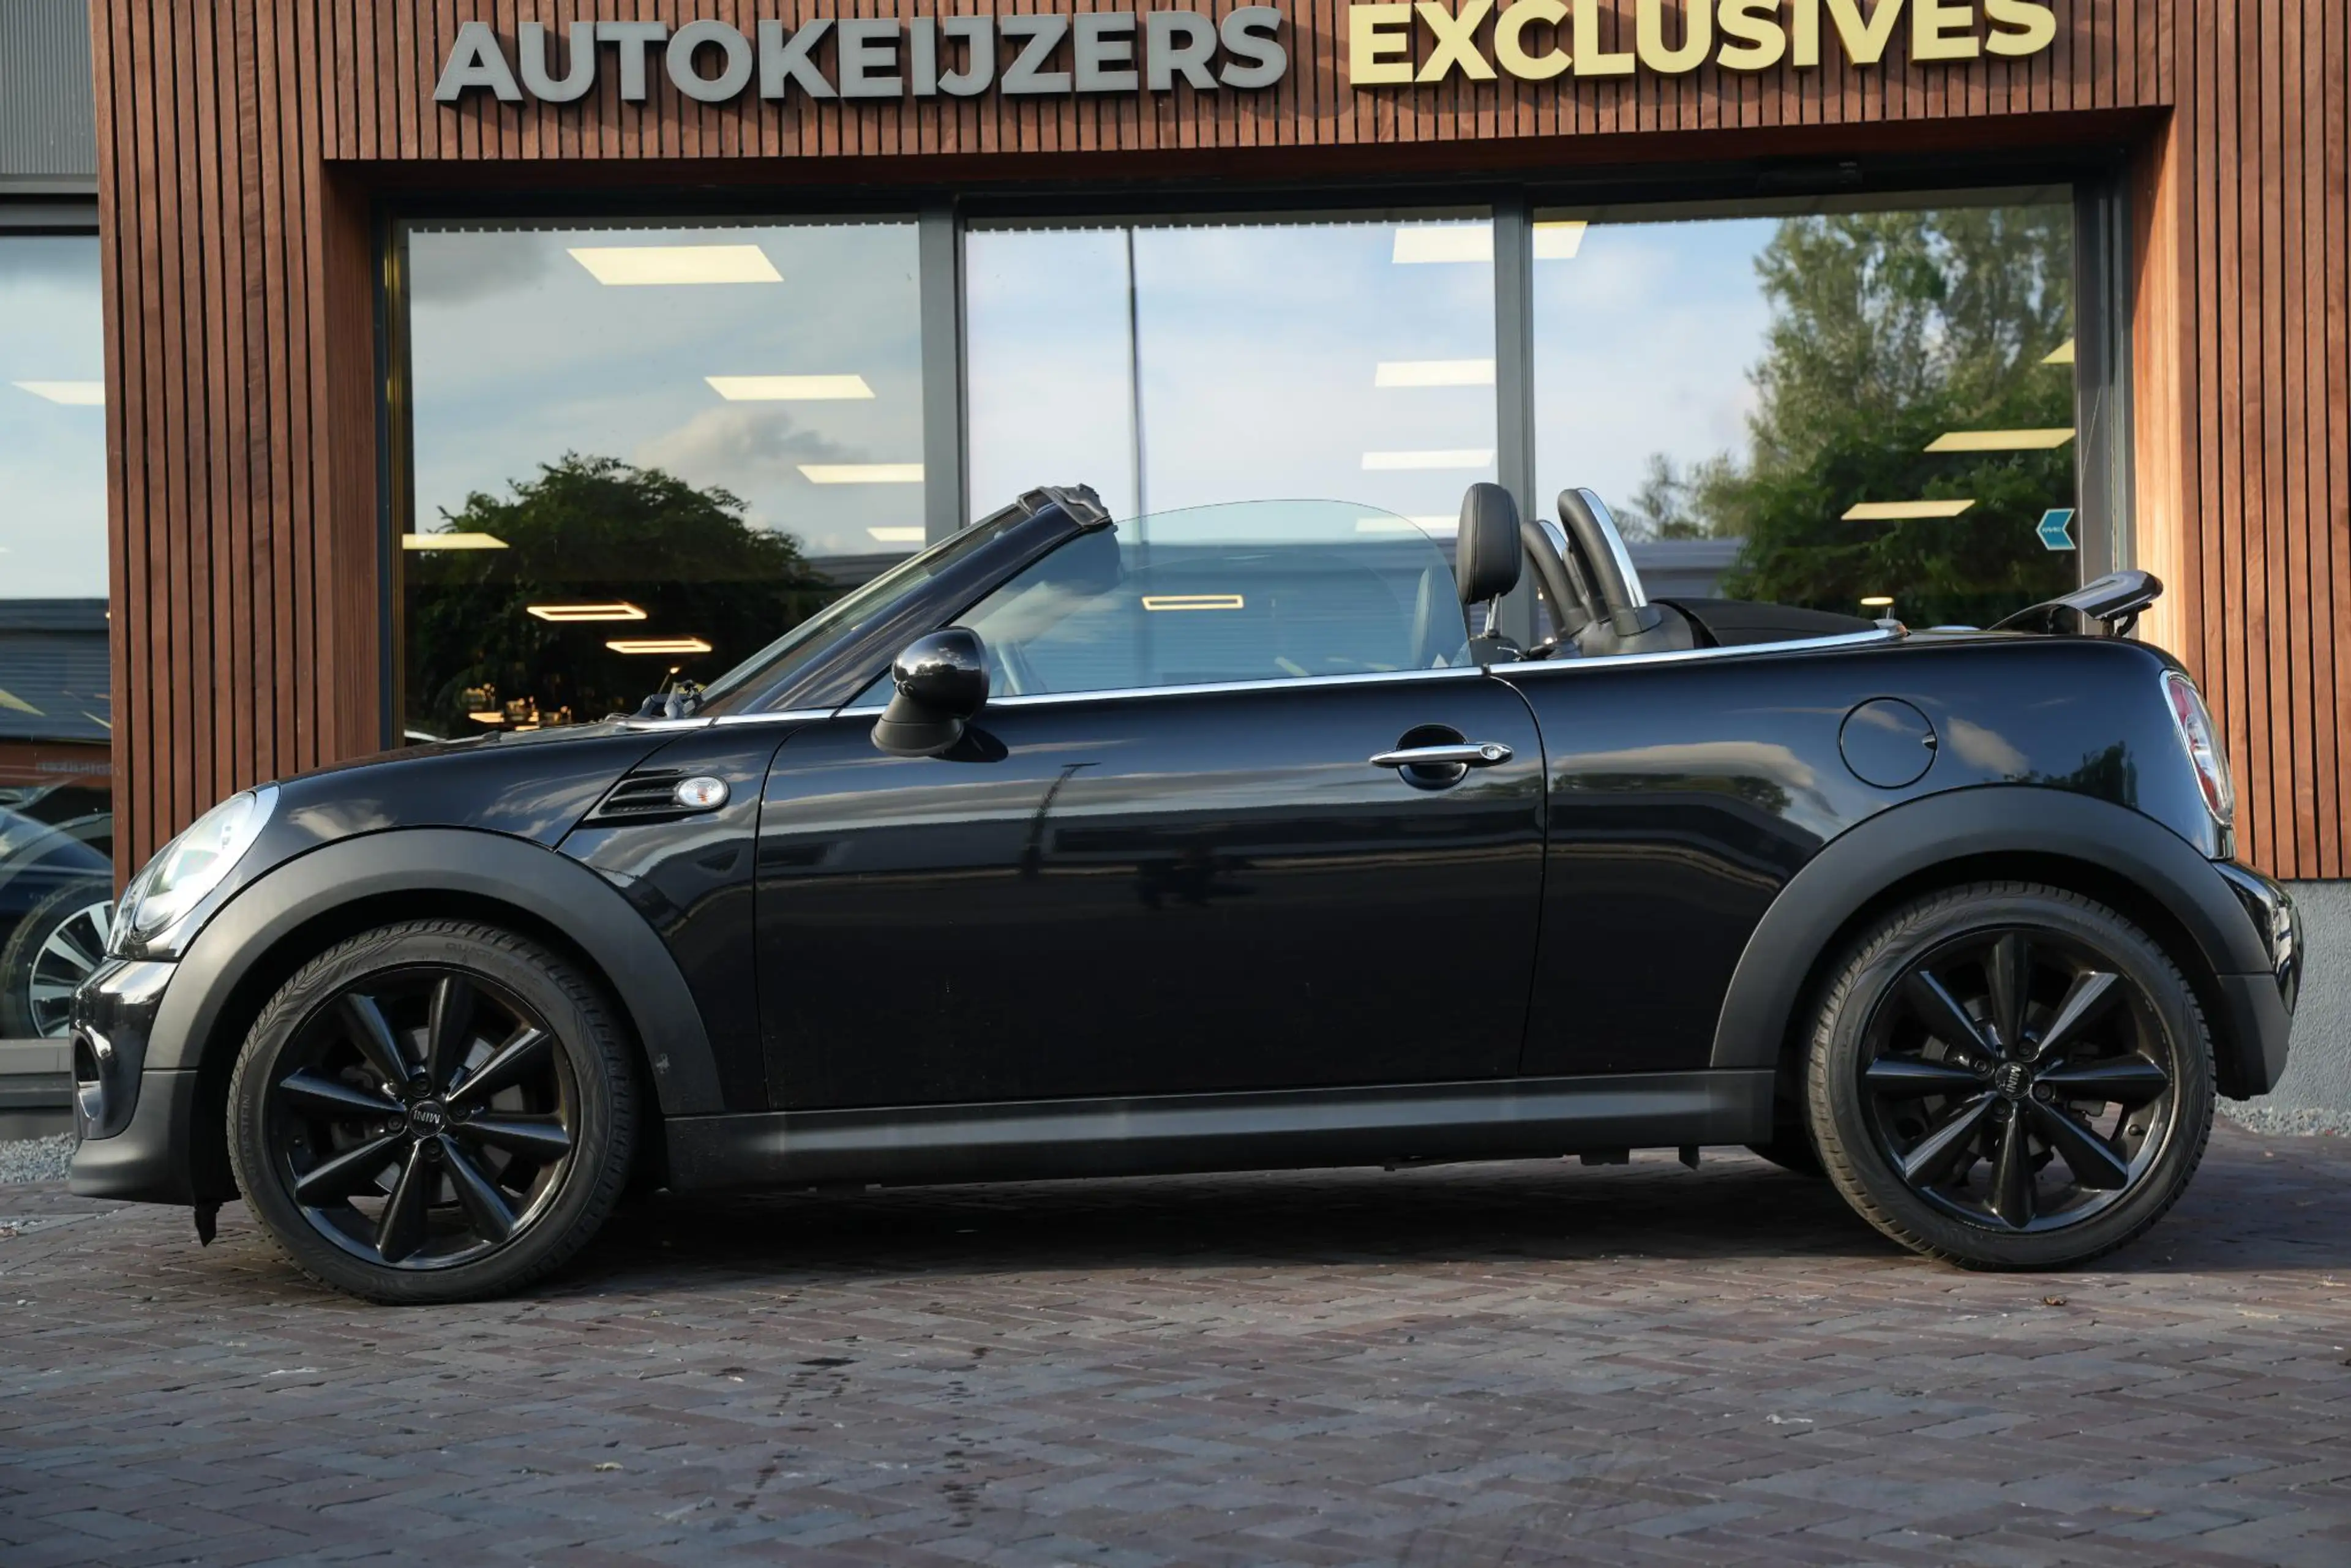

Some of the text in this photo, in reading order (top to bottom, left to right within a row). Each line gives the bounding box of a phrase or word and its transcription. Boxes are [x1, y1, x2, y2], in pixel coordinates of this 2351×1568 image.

[432, 0, 2057, 102] AUTOKEIJZERS EXCLUSIVES
[2006, 1065, 2022, 1093] MINI
[413, 1110, 441, 1124] MINI
